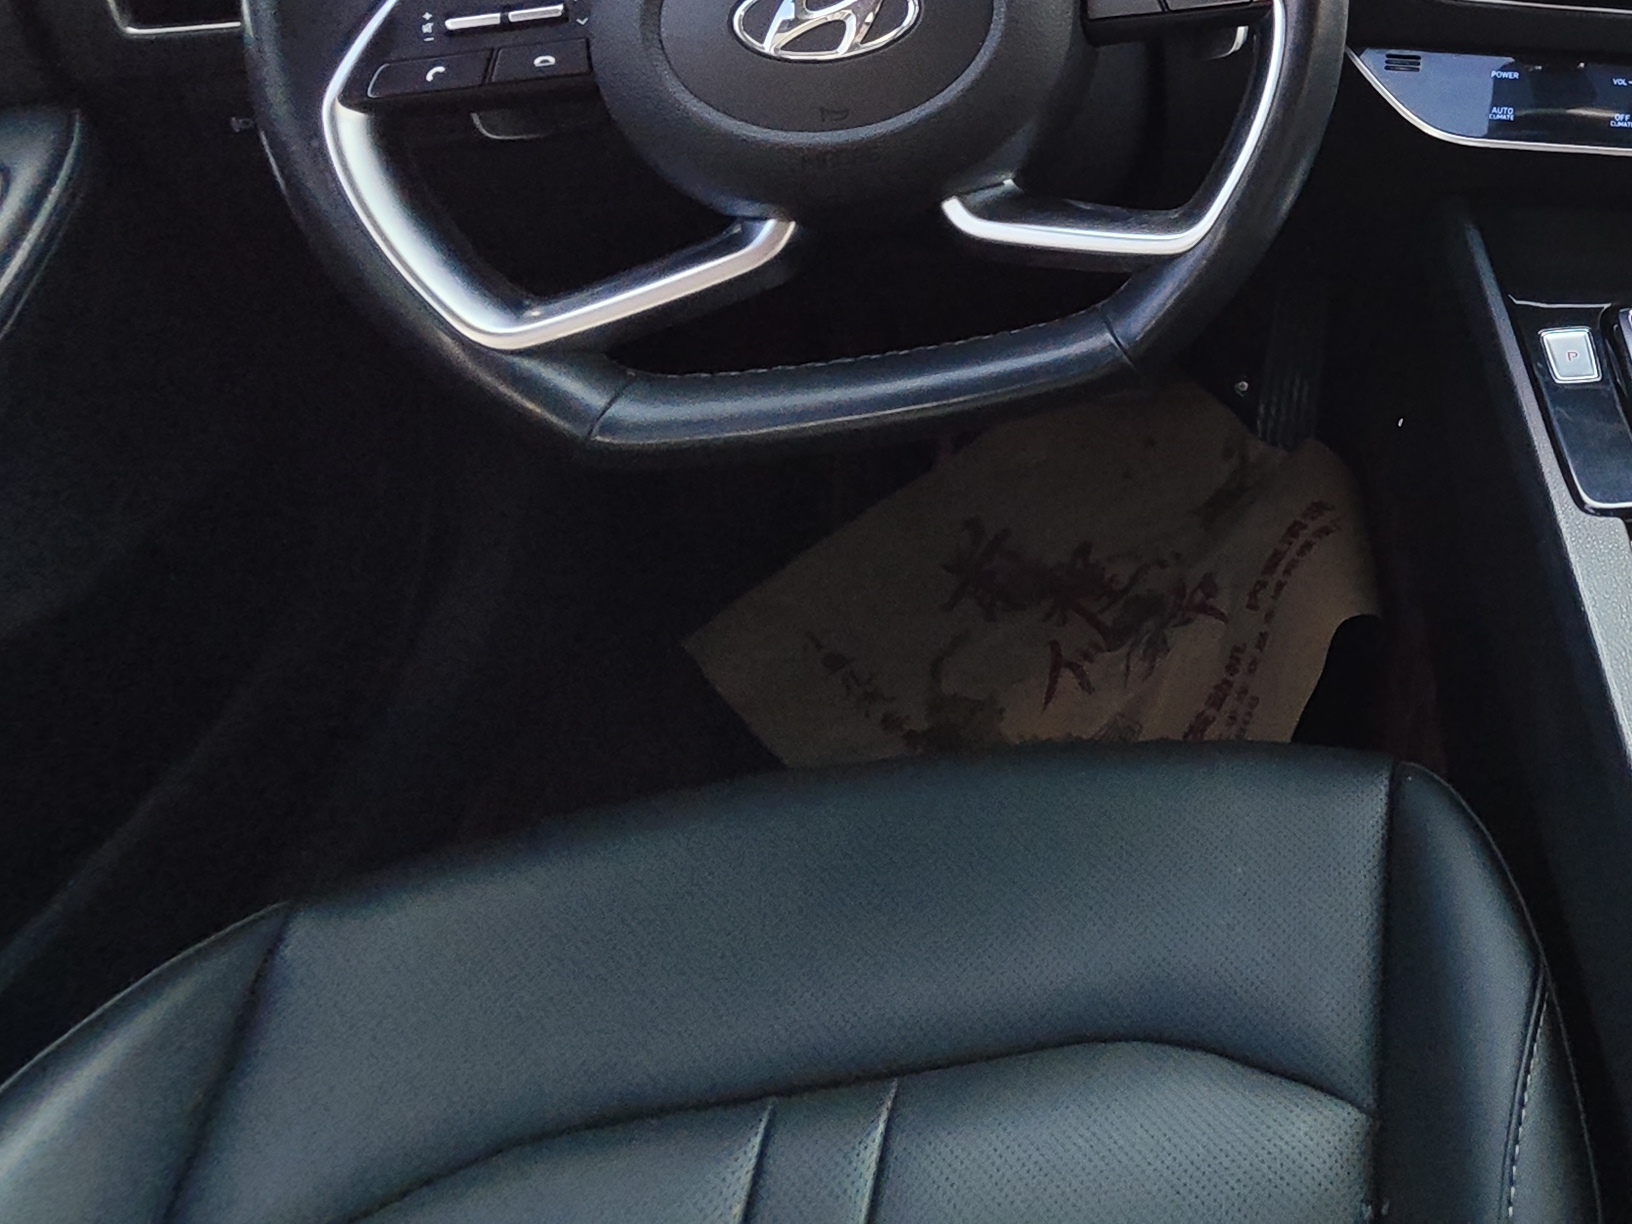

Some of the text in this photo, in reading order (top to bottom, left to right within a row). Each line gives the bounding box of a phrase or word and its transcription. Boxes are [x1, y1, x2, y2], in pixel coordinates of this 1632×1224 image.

[1491, 70, 1519, 80] POWER
[1492, 106, 1514, 115] AUTO
[1489, 113, 1514, 122] CLIMATE
[1615, 113, 1631, 122] OFF
[1567, 351, 1579, 362] P
